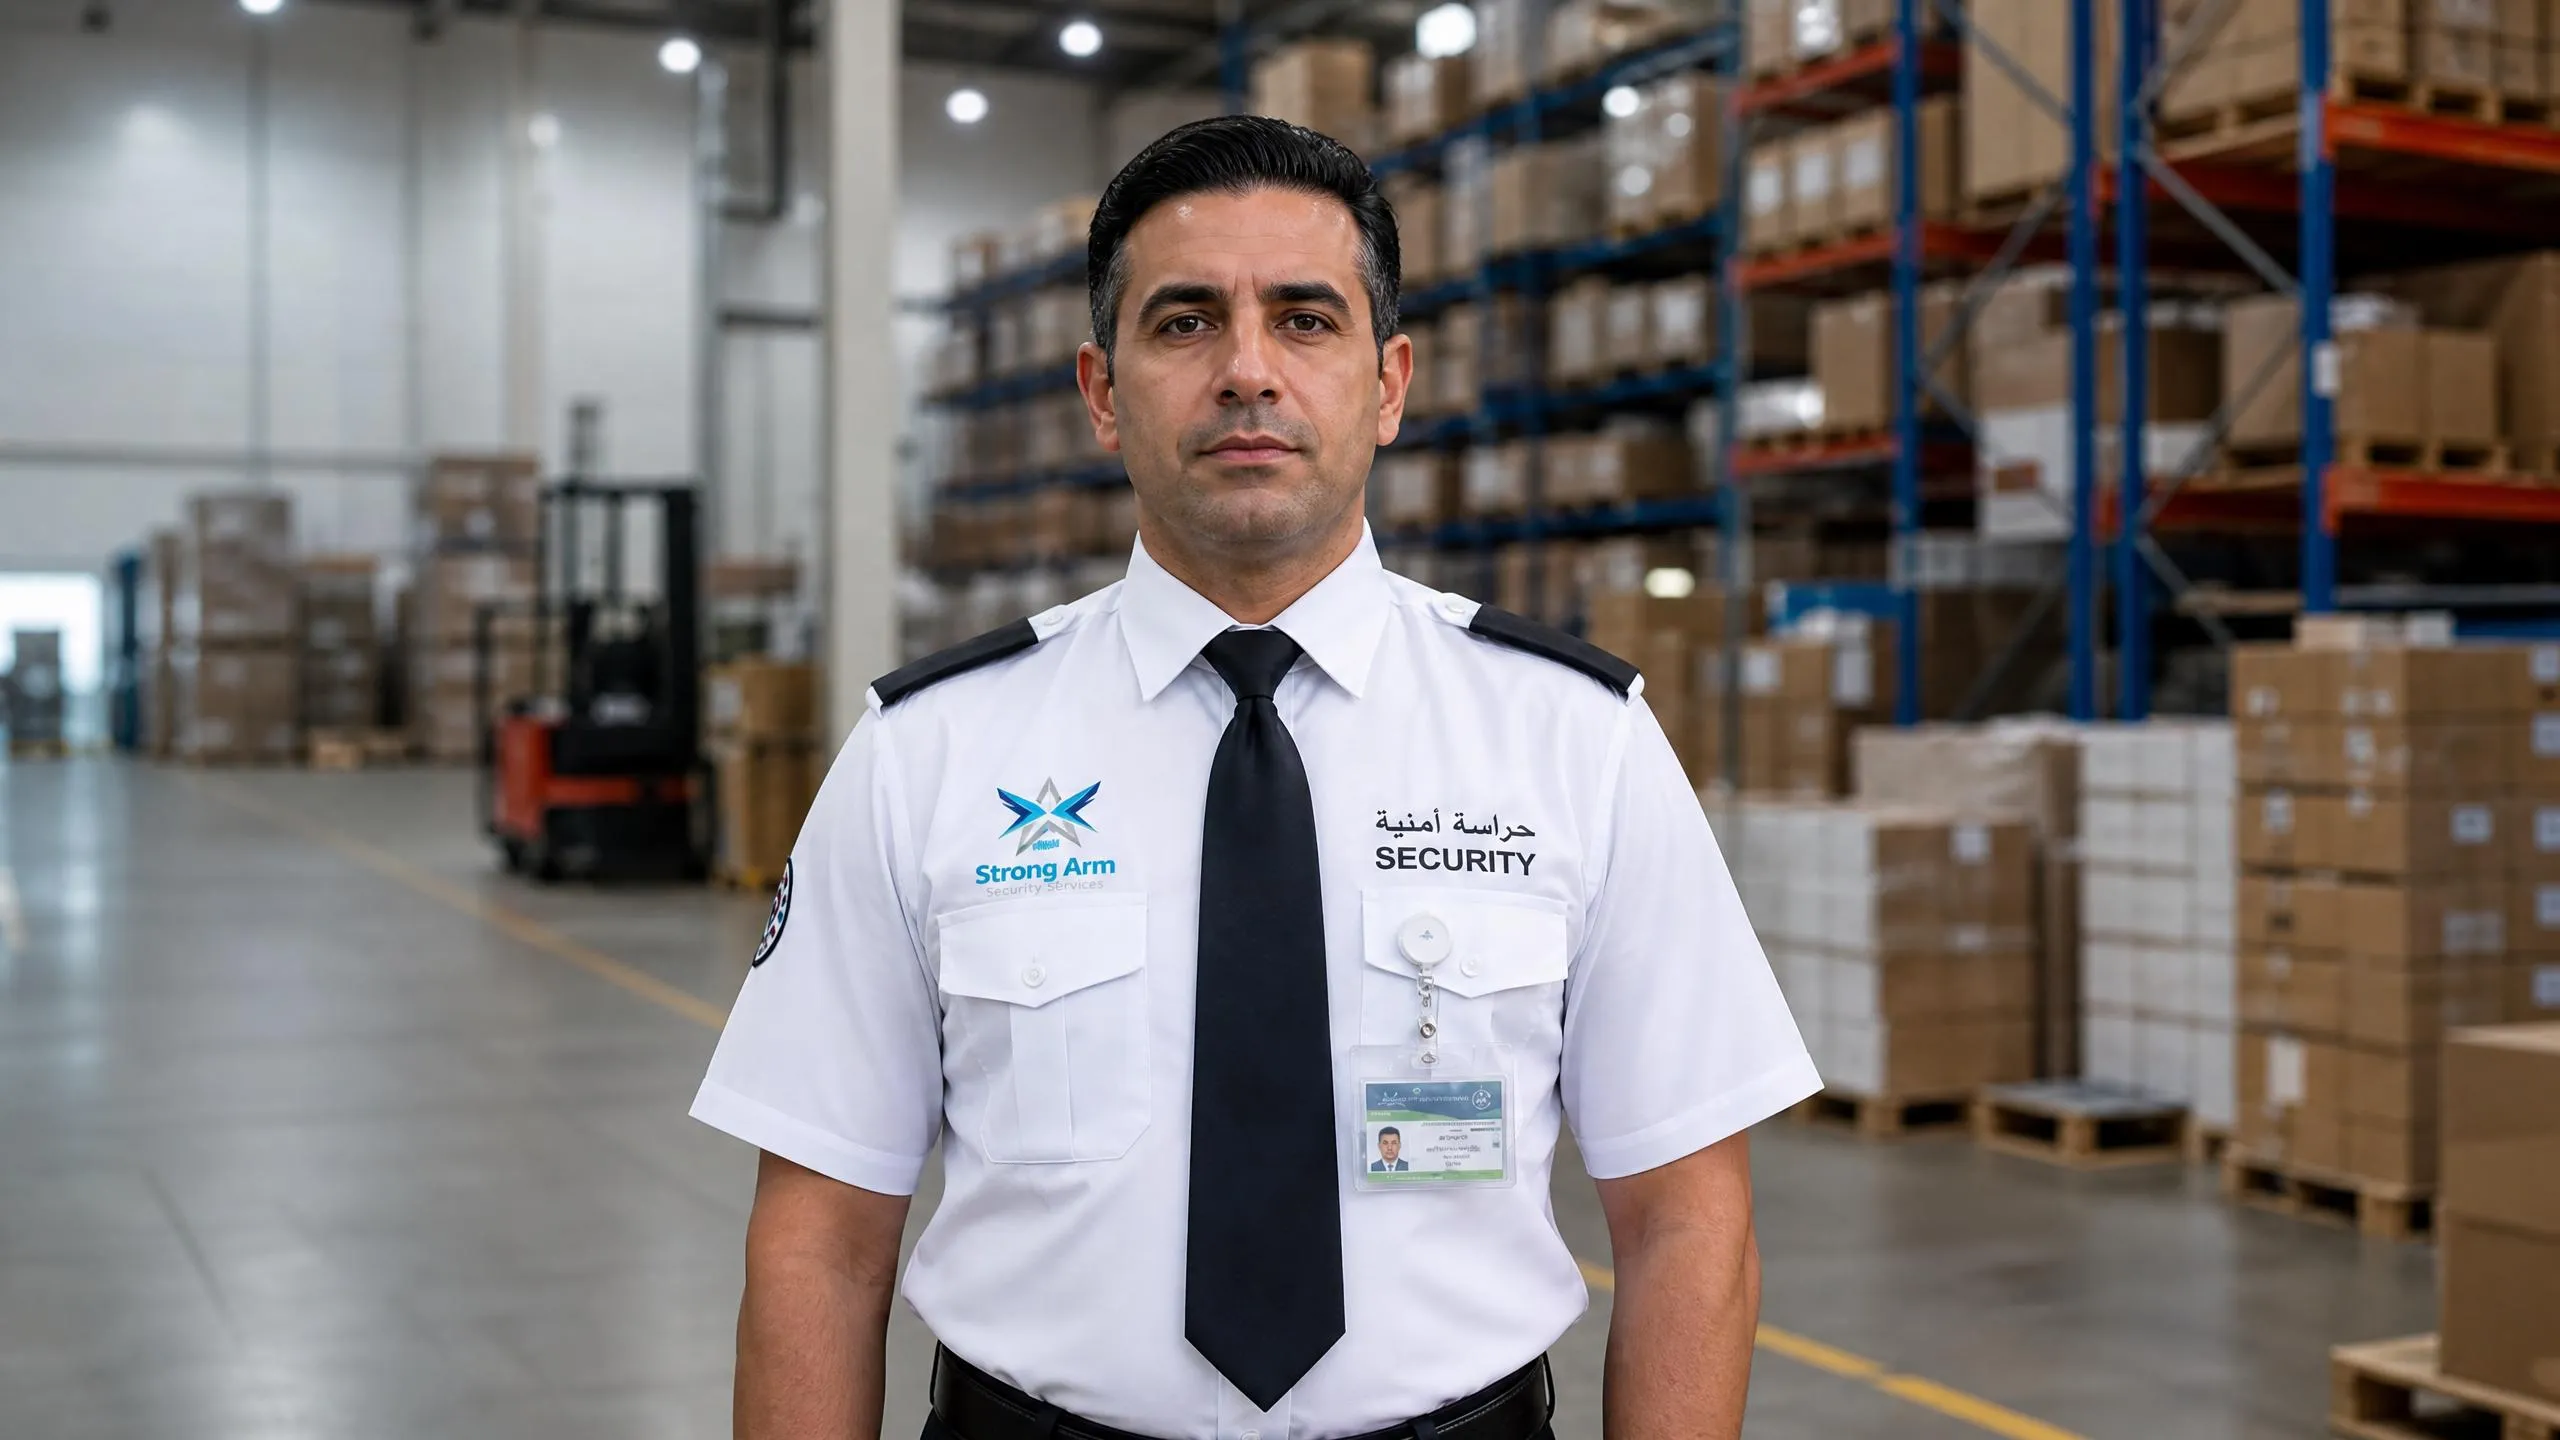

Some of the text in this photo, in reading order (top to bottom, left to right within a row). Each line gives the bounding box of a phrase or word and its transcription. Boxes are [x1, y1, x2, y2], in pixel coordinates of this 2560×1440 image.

[1375, 807, 1536, 842] حراسة أمنية
[976, 857, 1115, 884] Strong Arm
[1375, 846, 1536, 876] SECURITY
[986, 879, 1103, 897] Security Services
